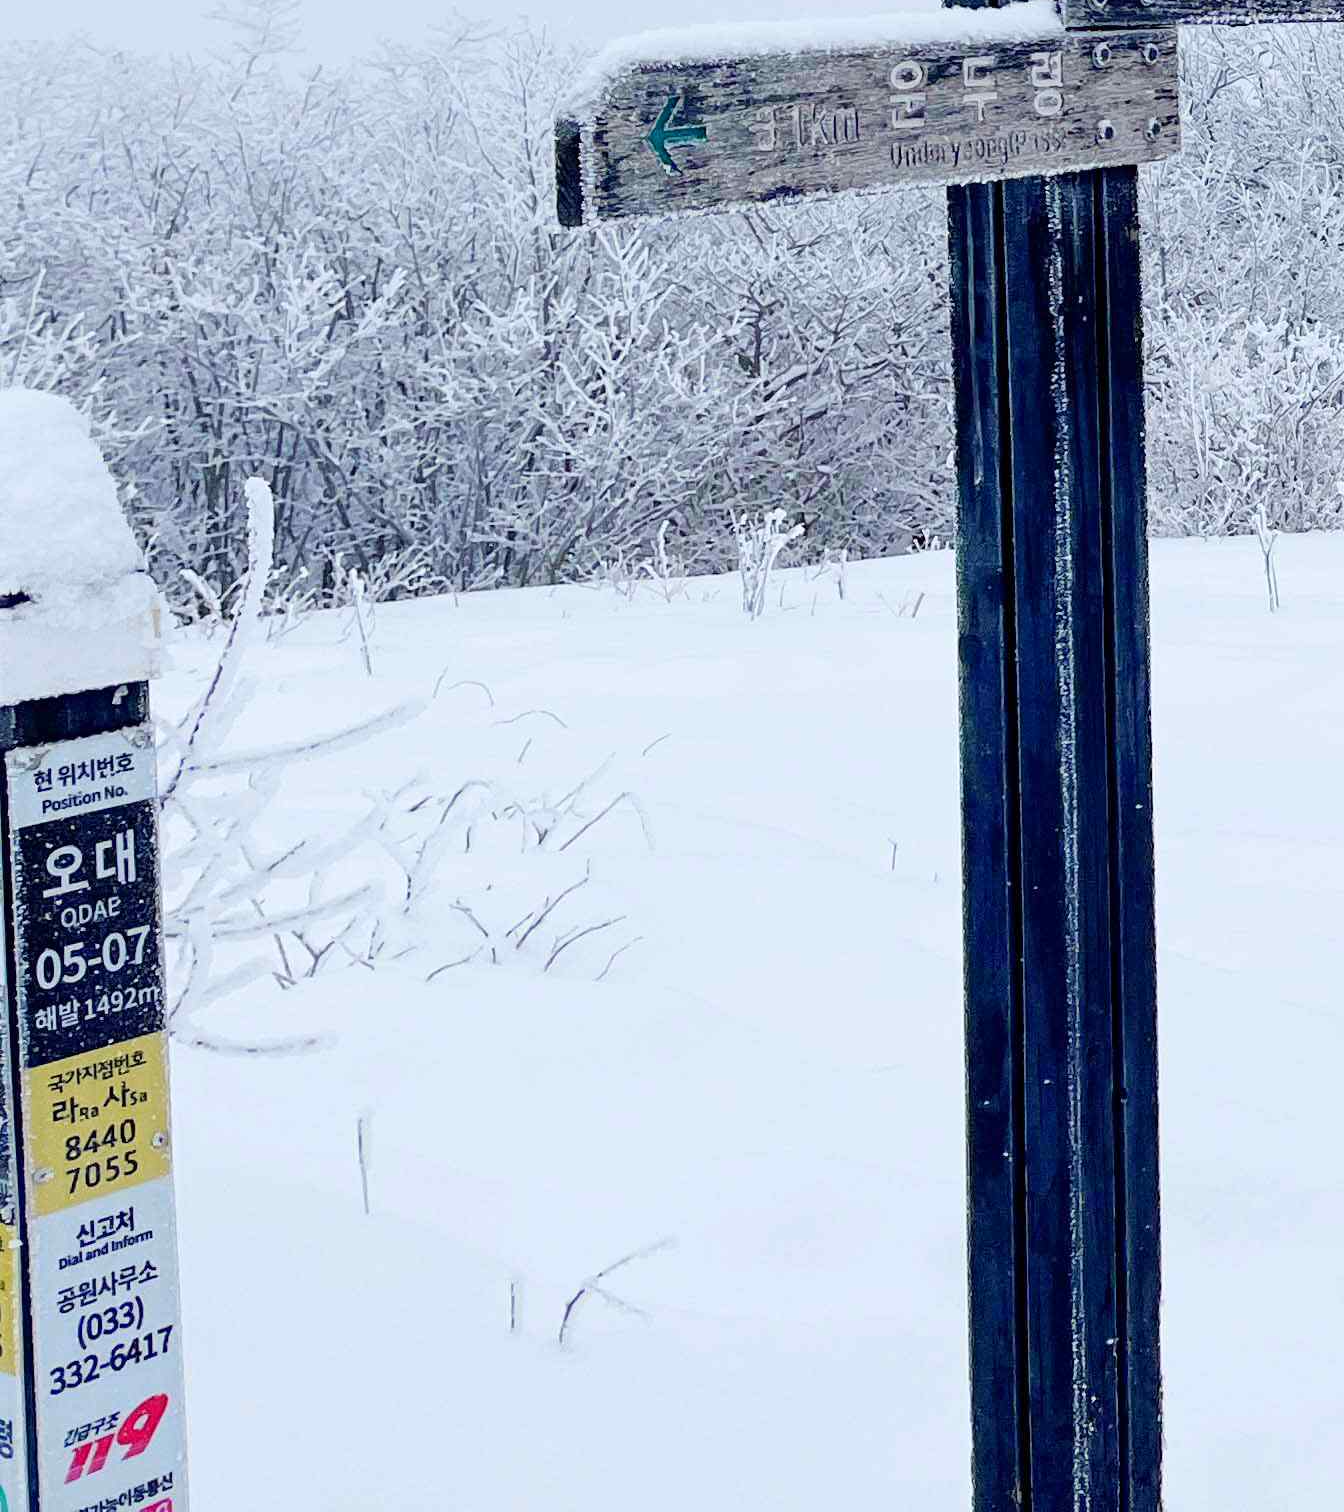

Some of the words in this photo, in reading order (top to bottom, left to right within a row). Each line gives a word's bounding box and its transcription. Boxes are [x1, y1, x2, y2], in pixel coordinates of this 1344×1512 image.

[889, 51, 1065, 129] 운두령
[33, 770, 53, 793] 현
[57, 752, 135, 787] 위치번호
[42, 789, 101, 815] Position
[104, 784, 128, 799] No.
[36, 925, 151, 991] 05-07
[34, 998, 81, 1032] 해발
[84, 985, 160, 1022] 1492m
[48, 1050, 148, 1094] 국가지점번호
[65, 1118, 136, 1161] 8440
[66, 1150, 138, 1194] 7055
[76, 1206, 135, 1248] 신고처
[58, 1251, 83, 1271] Dial
[85, 1242, 109, 1262] and
[111, 1230, 153, 1252] Inform
[56, 1260, 159, 1314] 공원사무소
[77, 1295, 144, 1350] (033)
[49, 1324, 174, 1396] 332-6417
[64, 1411, 120, 1448] 긴급구조
[64, 1393, 168, 1485] 119
